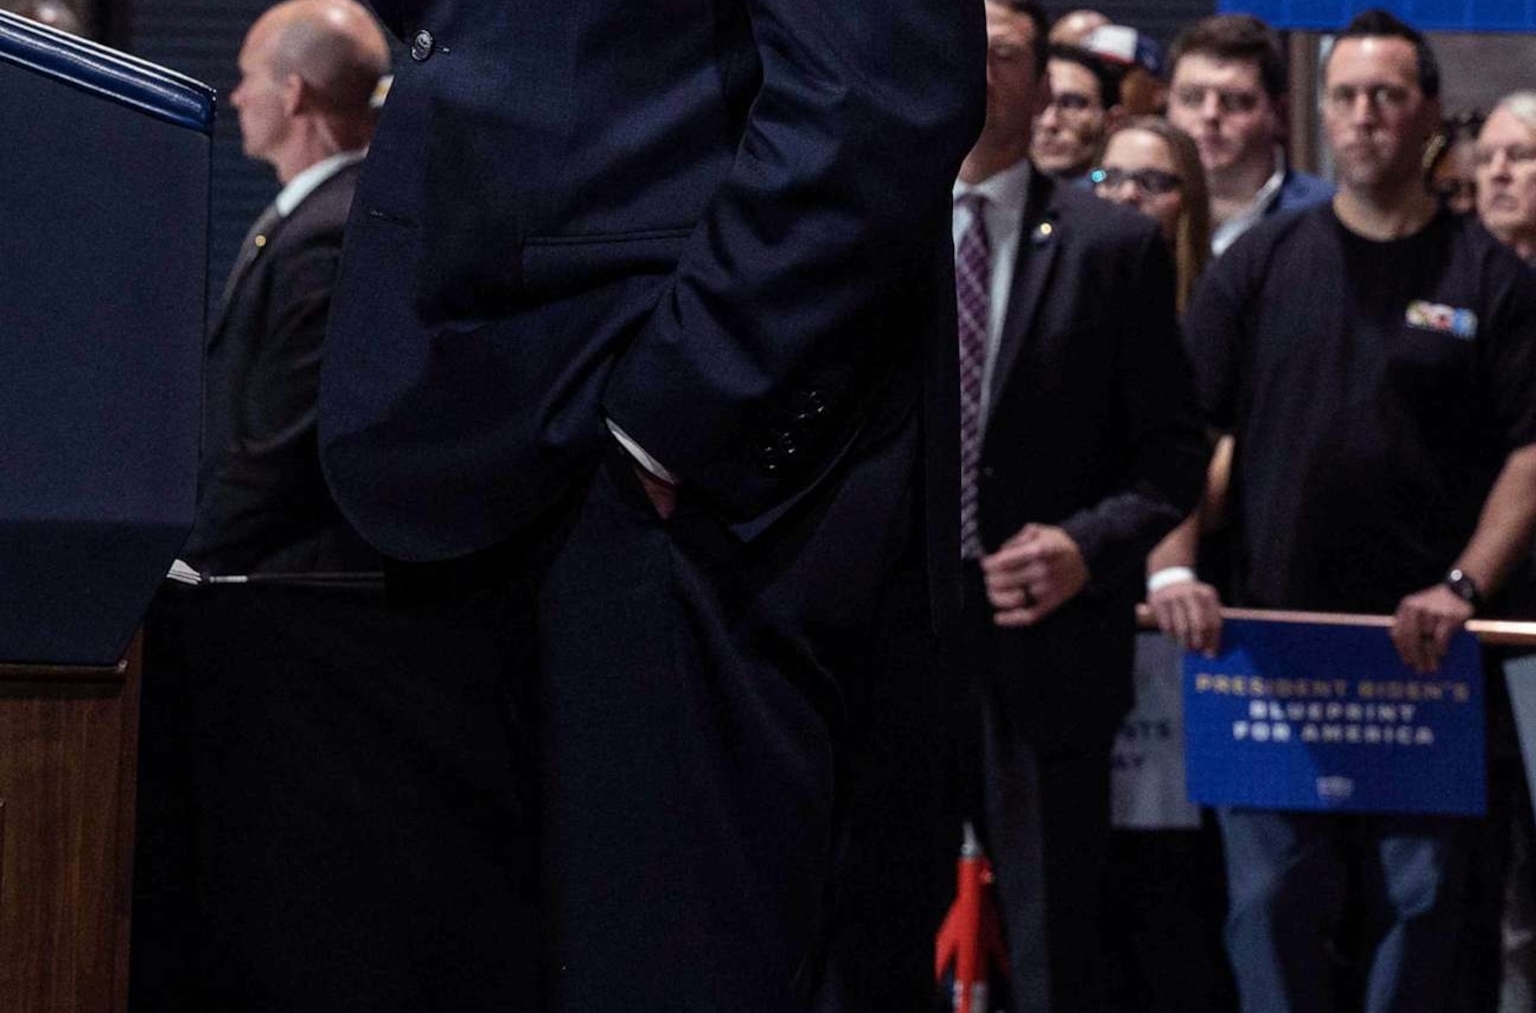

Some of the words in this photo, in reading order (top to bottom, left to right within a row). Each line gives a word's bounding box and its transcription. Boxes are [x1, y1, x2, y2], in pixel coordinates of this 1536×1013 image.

[1249, 699, 1416, 724] BLUEPRINT
[1232, 721, 1291, 743] FOR
[1301, 724, 1435, 746] AMERICA
